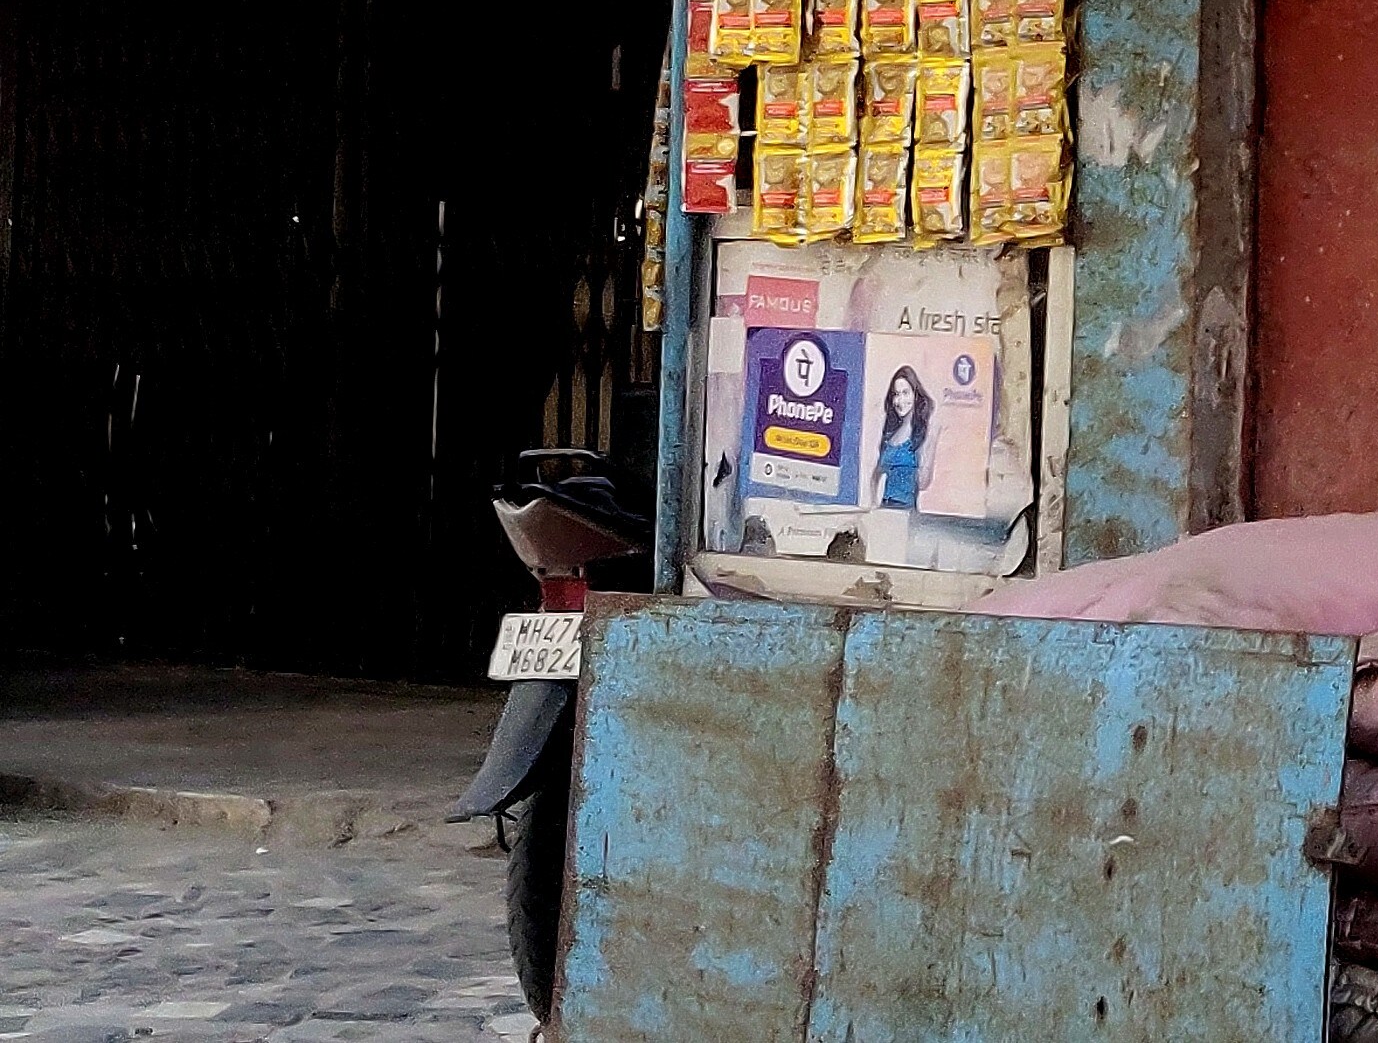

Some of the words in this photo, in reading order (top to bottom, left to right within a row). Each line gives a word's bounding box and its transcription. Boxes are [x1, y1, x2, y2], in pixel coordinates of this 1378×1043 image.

[898, 306, 912, 331] A
[919, 306, 966, 338] fresh
[766, 393, 835, 425] PhonePe
